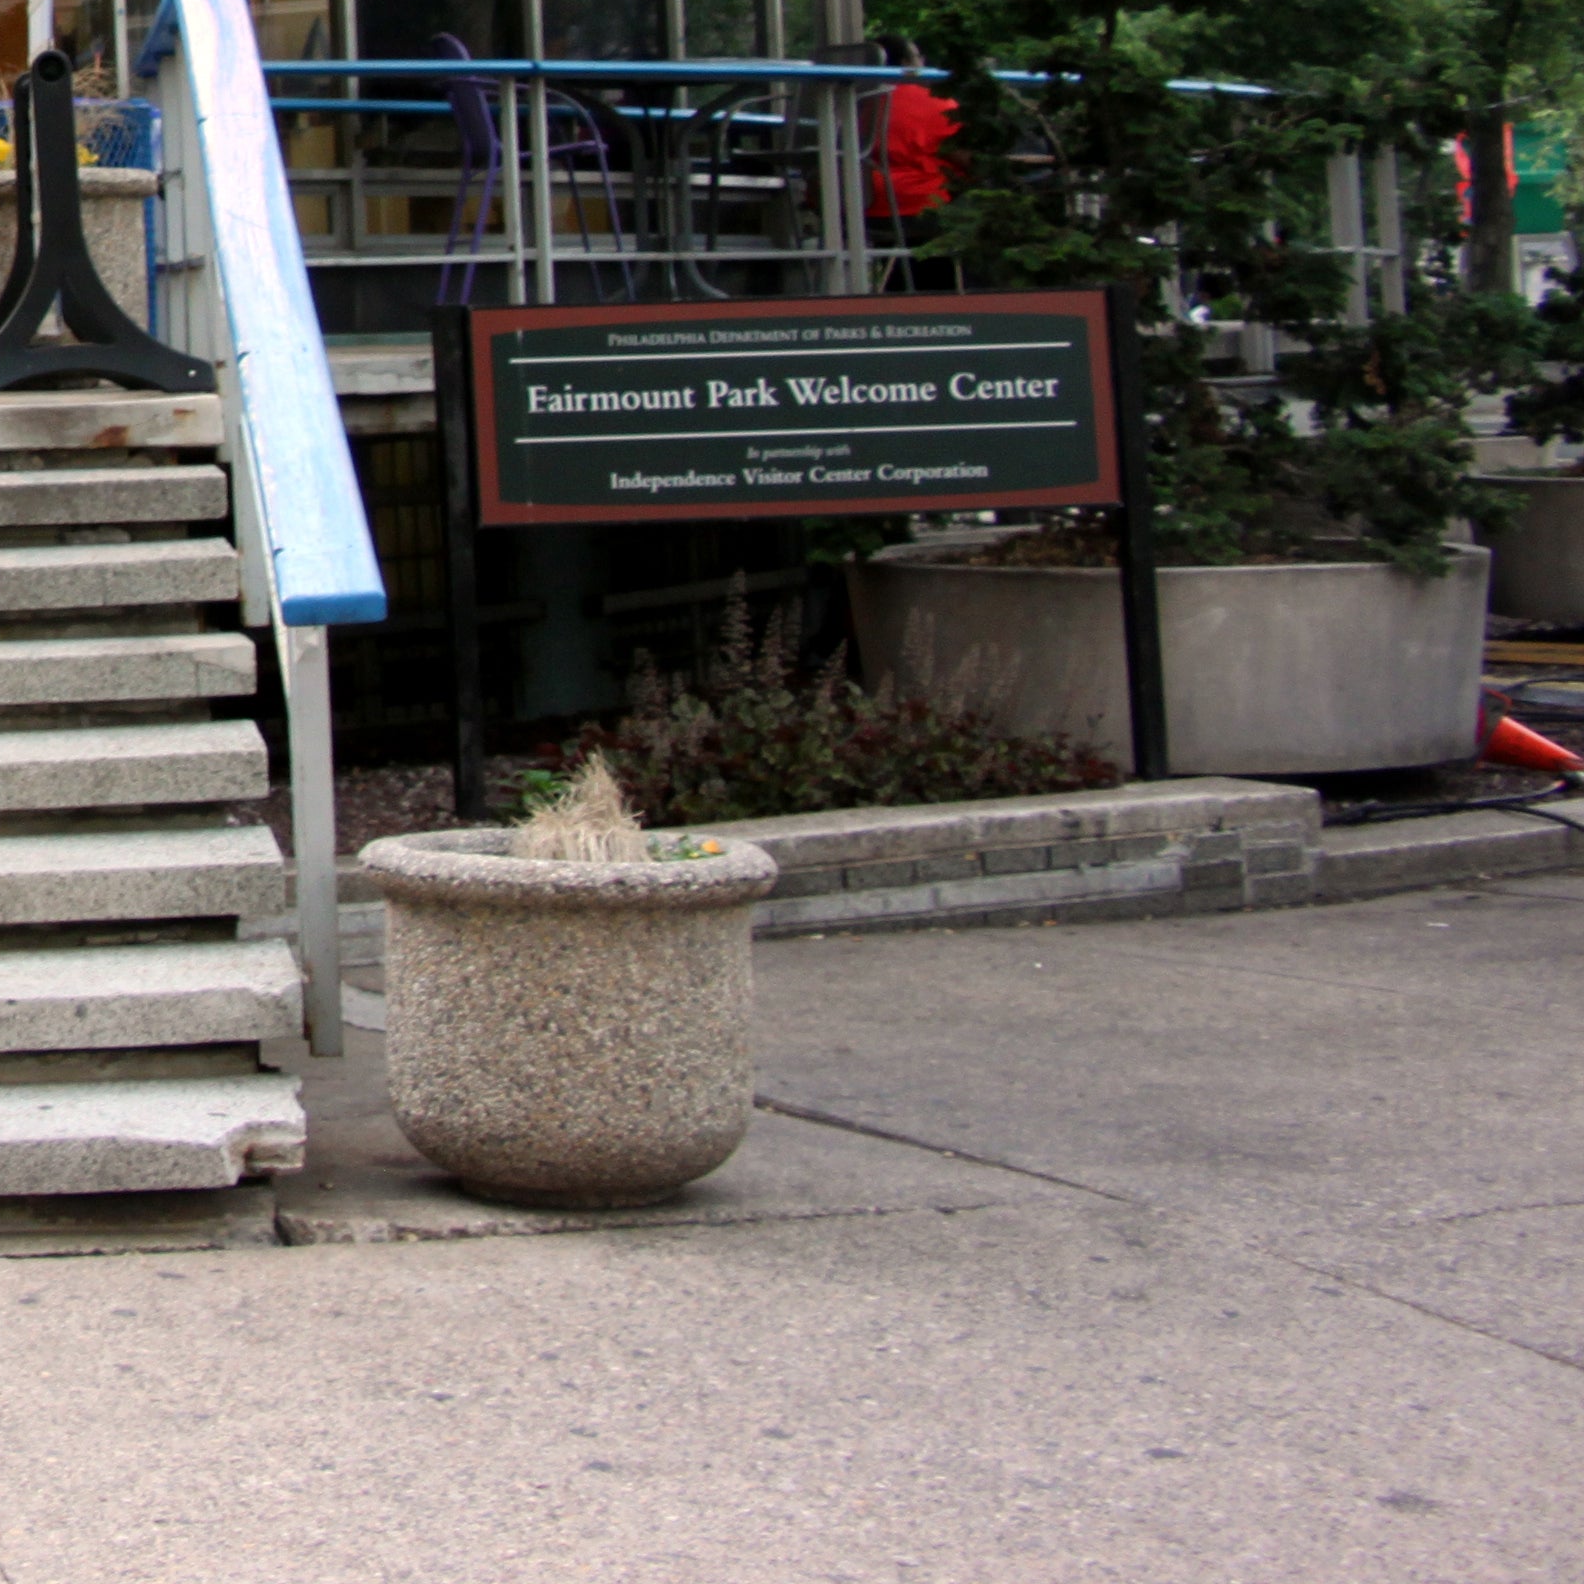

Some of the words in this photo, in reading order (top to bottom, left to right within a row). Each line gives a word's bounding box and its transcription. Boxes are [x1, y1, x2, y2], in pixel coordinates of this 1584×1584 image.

[608, 333, 706, 346] PHILADELPHIA
[709, 329, 798, 344] DEPARTMENT
[802, 328, 819, 340] OF
[824, 326, 867, 340] PARKS
[870, 325, 882, 338] &
[885, 324, 972, 337] RECREATION
[527, 383, 696, 414] Fairmount
[706, 377, 779, 409] Park
[785, 375, 937, 406] Welcome
[948, 372, 1060, 402] Center
[610, 470, 735, 494] Independence
[743, 466, 803, 485] Visitor
[808, 464, 872, 484] Center
[877, 461, 989, 486] Corporation
